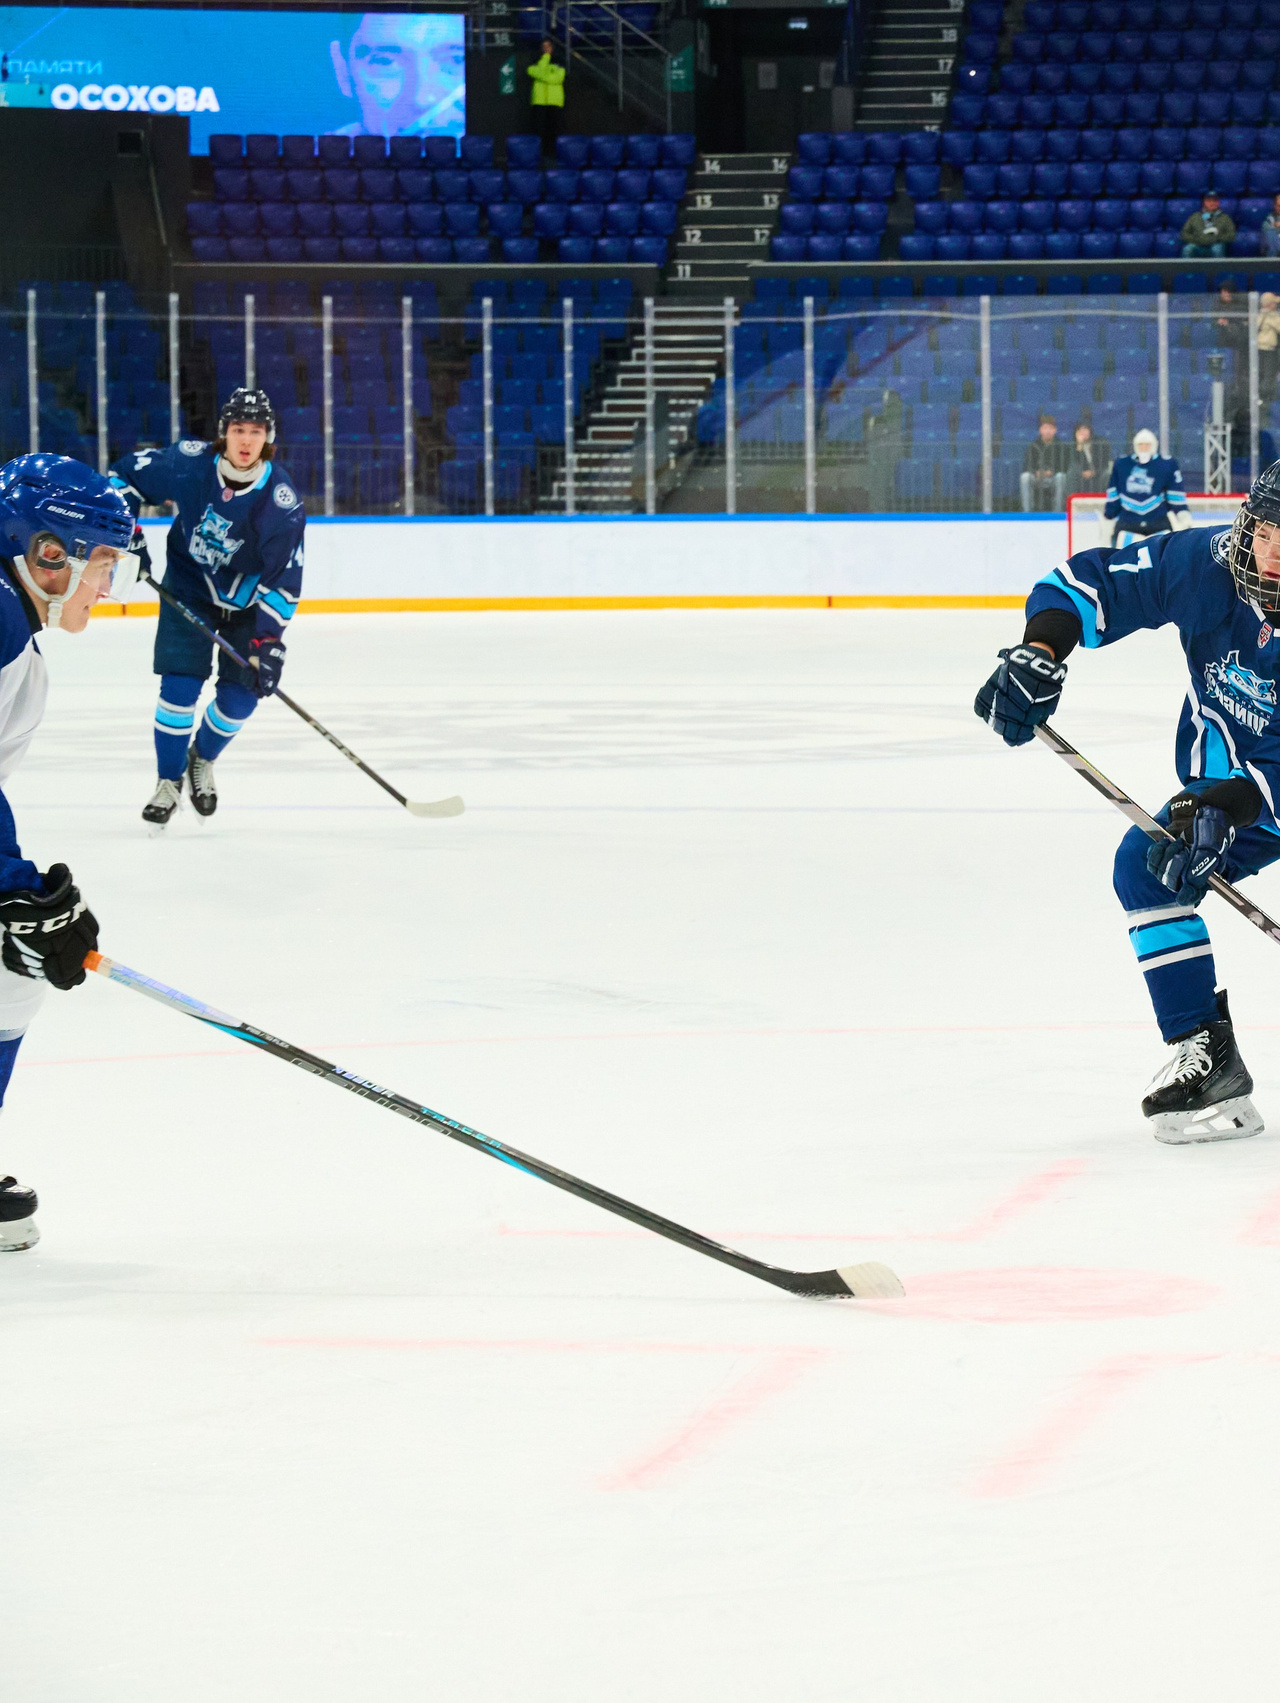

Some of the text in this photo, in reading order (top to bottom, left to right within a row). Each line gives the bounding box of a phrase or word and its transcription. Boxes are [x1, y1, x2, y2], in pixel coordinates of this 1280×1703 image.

[9, 59, 103, 75] ПАМЯТИ
[938, 59, 954, 73] 17
[51, 83, 220, 112] ОСОХОВА
[704, 160, 720, 172] 14
[696, 195, 712, 209] 13
[763, 194, 779, 209] 13
[685, 230, 702, 245] 12
[754, 229, 770, 244] 12
[677, 265, 691, 280] 11
[47, 505, 86, 520] BAUER
[1108, 546, 1153, 573] 7
[1170, 799, 1193, 811] CCM
[1191, 856, 1210, 875] CCM
